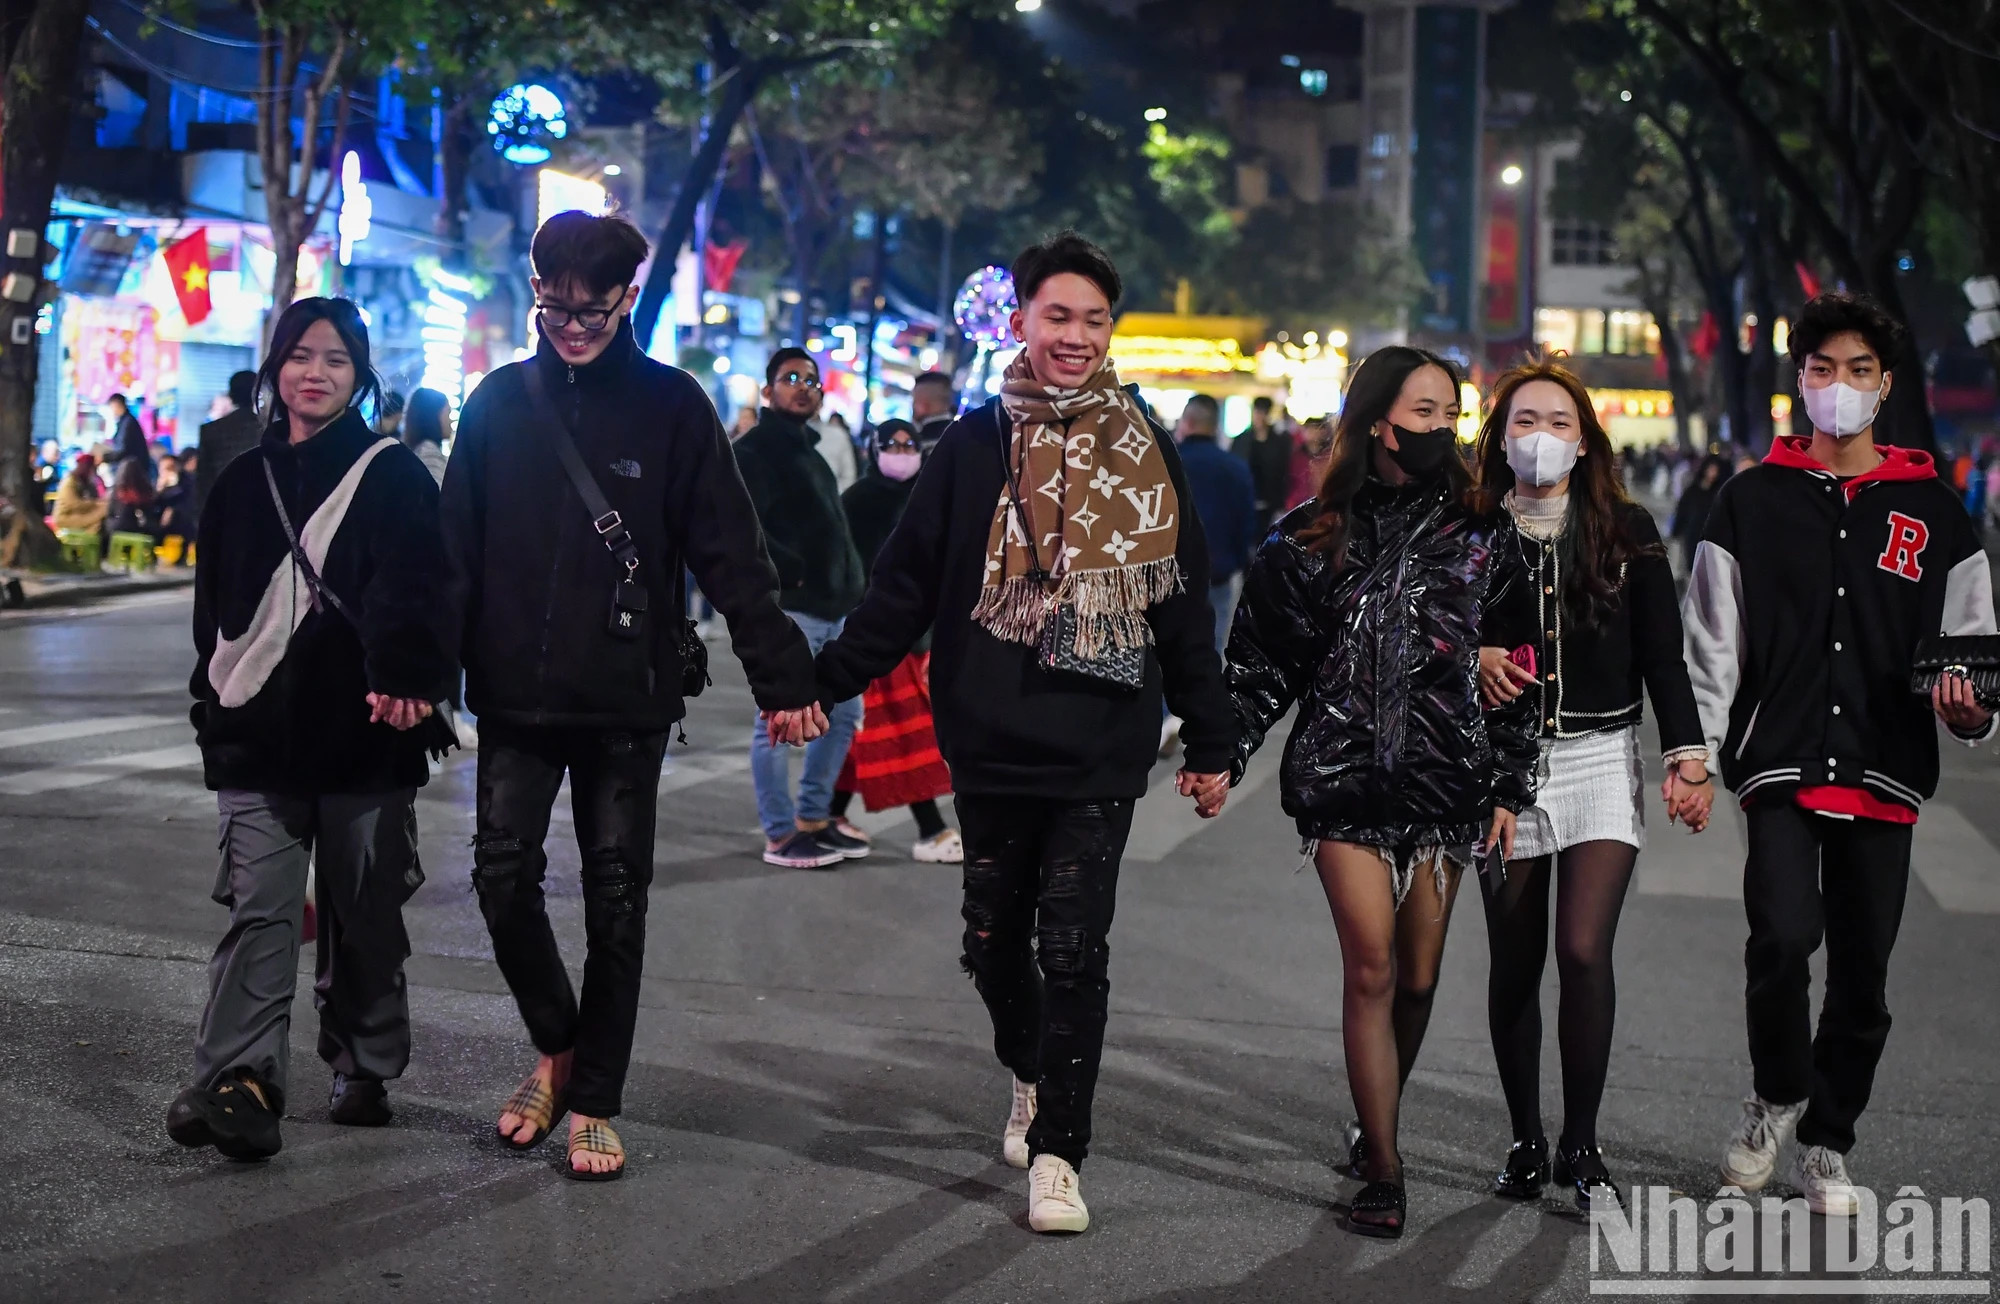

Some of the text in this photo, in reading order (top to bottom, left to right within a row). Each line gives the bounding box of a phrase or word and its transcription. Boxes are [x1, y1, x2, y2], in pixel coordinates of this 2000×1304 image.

[1119, 483, 1174, 536] LV
[1877, 510, 1930, 582] R
[619, 611, 632, 628] NY
